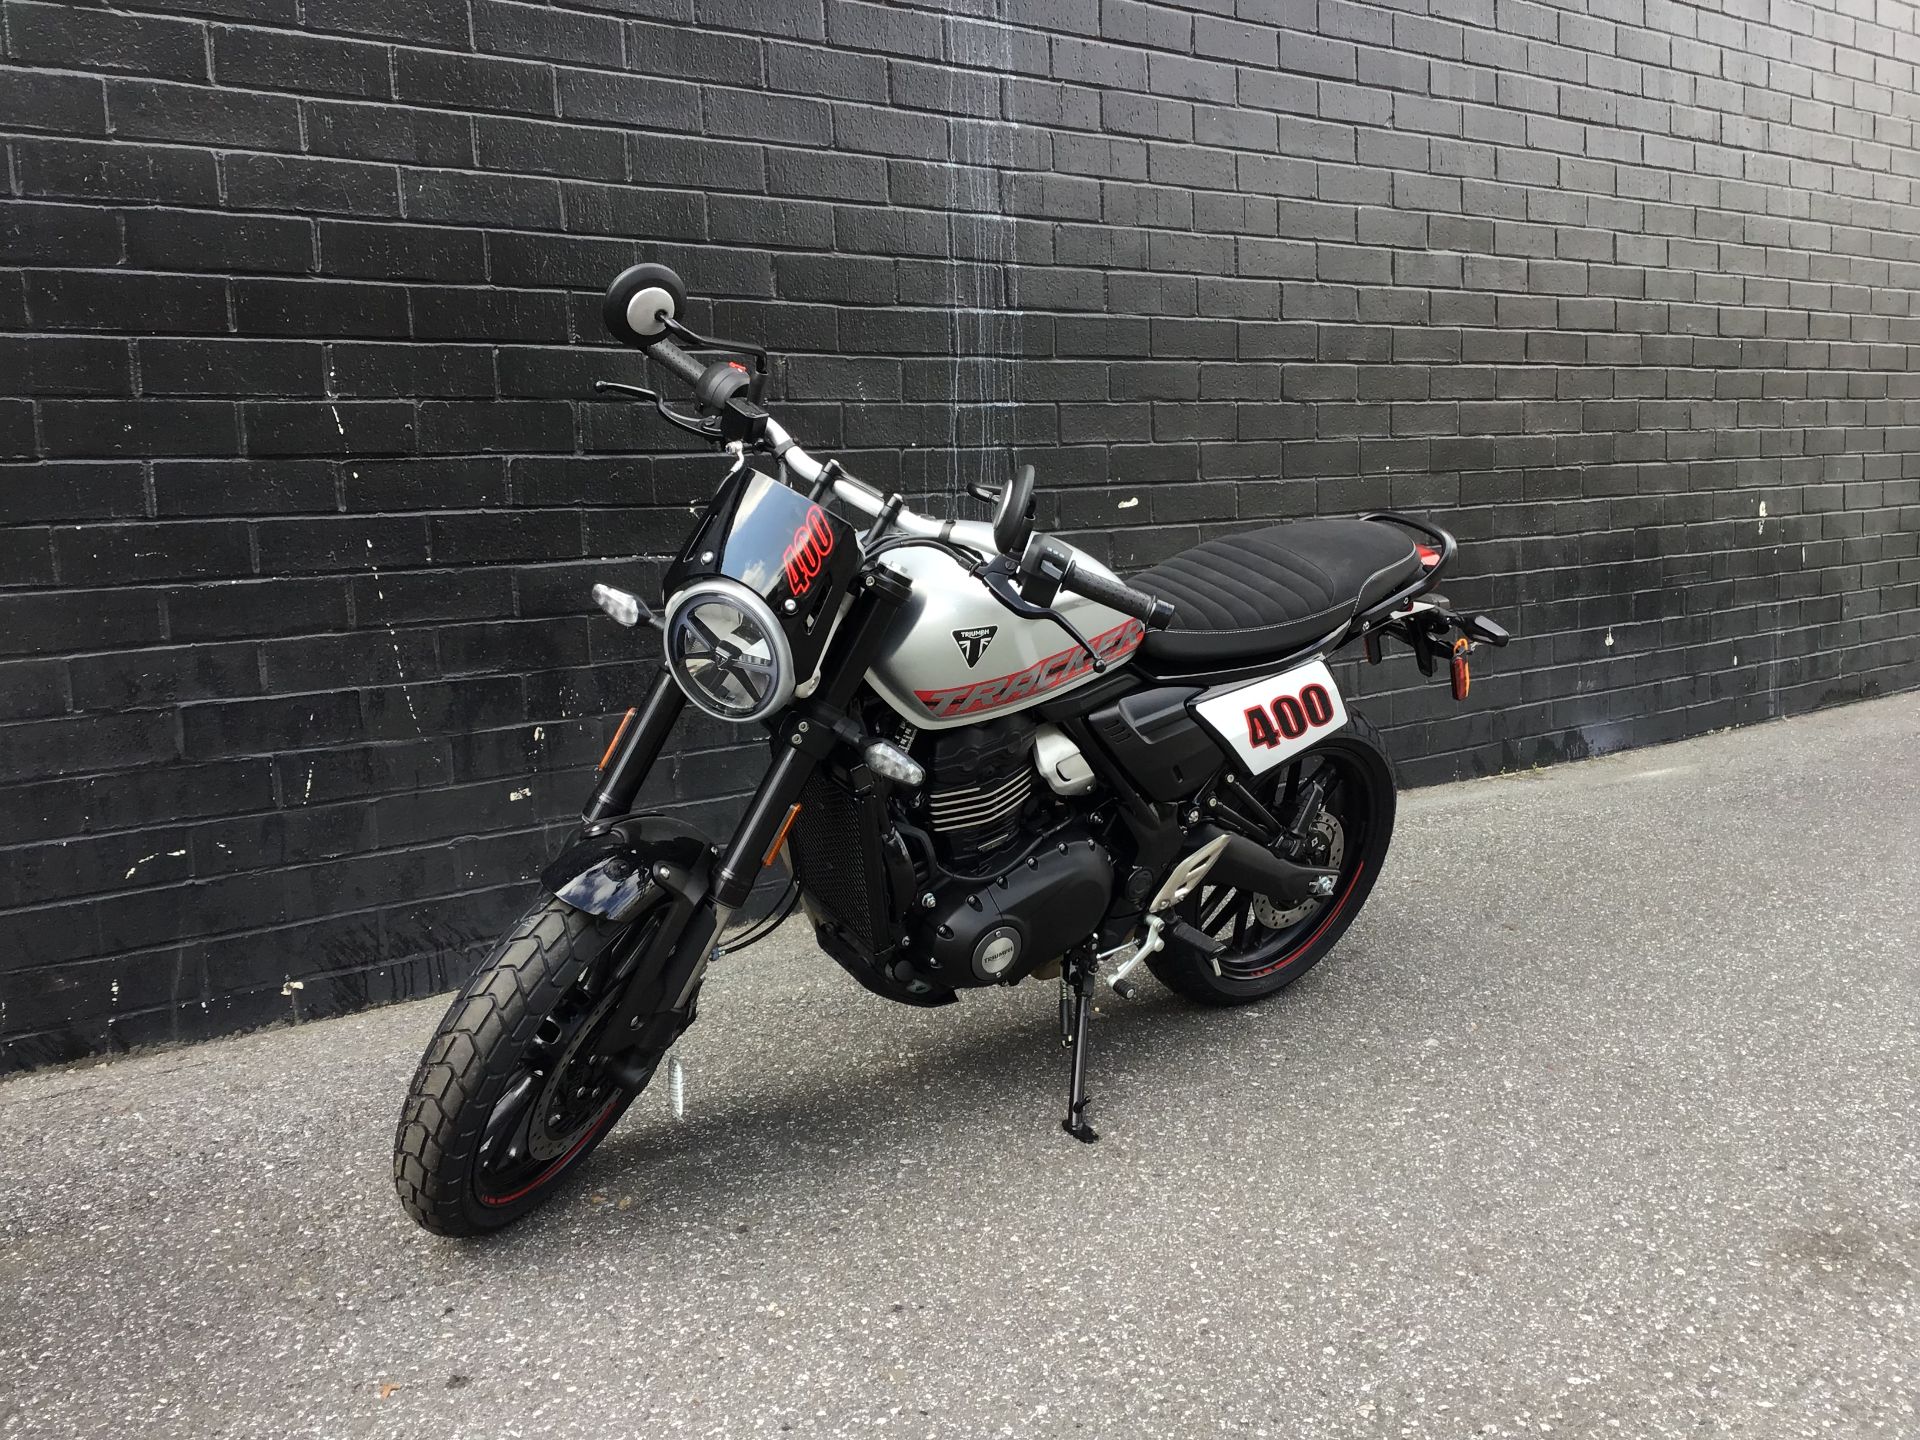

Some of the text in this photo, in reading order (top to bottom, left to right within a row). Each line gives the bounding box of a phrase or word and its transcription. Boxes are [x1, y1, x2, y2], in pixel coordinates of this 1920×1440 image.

[783, 505, 834, 597] 400
[961, 629, 990, 639] TRIUMPH
[930, 620, 1142, 716] TRACKER
[1244, 683, 1335, 750] 400
[984, 946, 1013, 964] TRIUMPH
